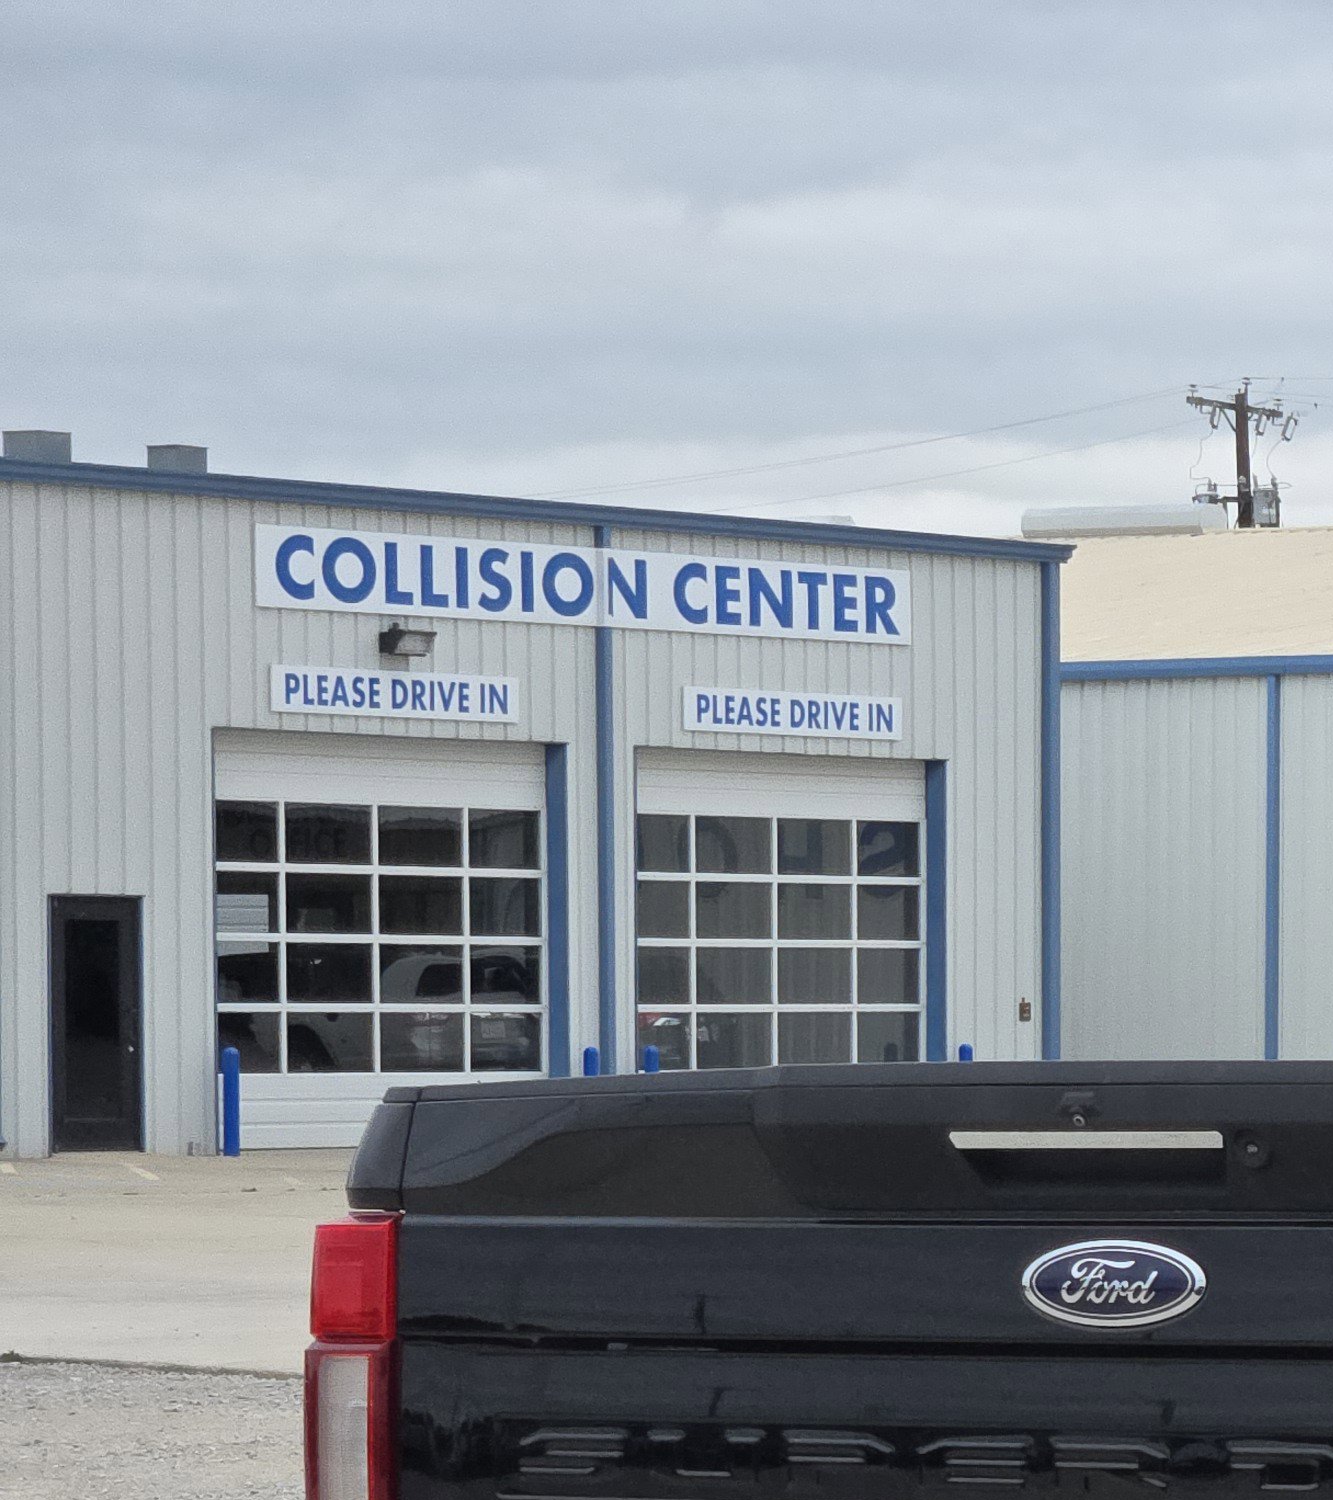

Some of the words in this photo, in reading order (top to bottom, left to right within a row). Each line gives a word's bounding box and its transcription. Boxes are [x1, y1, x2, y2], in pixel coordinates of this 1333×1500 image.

[275, 534, 647, 619] COLLISION
[673, 563, 900, 635] CENTER
[285, 673, 381, 708] PLEASE
[391, 679, 470, 713] DRIVE
[480, 683, 509, 714] IN
[697, 694, 781, 727] PLEASE
[790, 699, 859, 731] DRIVE
[868, 703, 893, 733] IN
[1060, 1258, 1159, 1304] Ford
